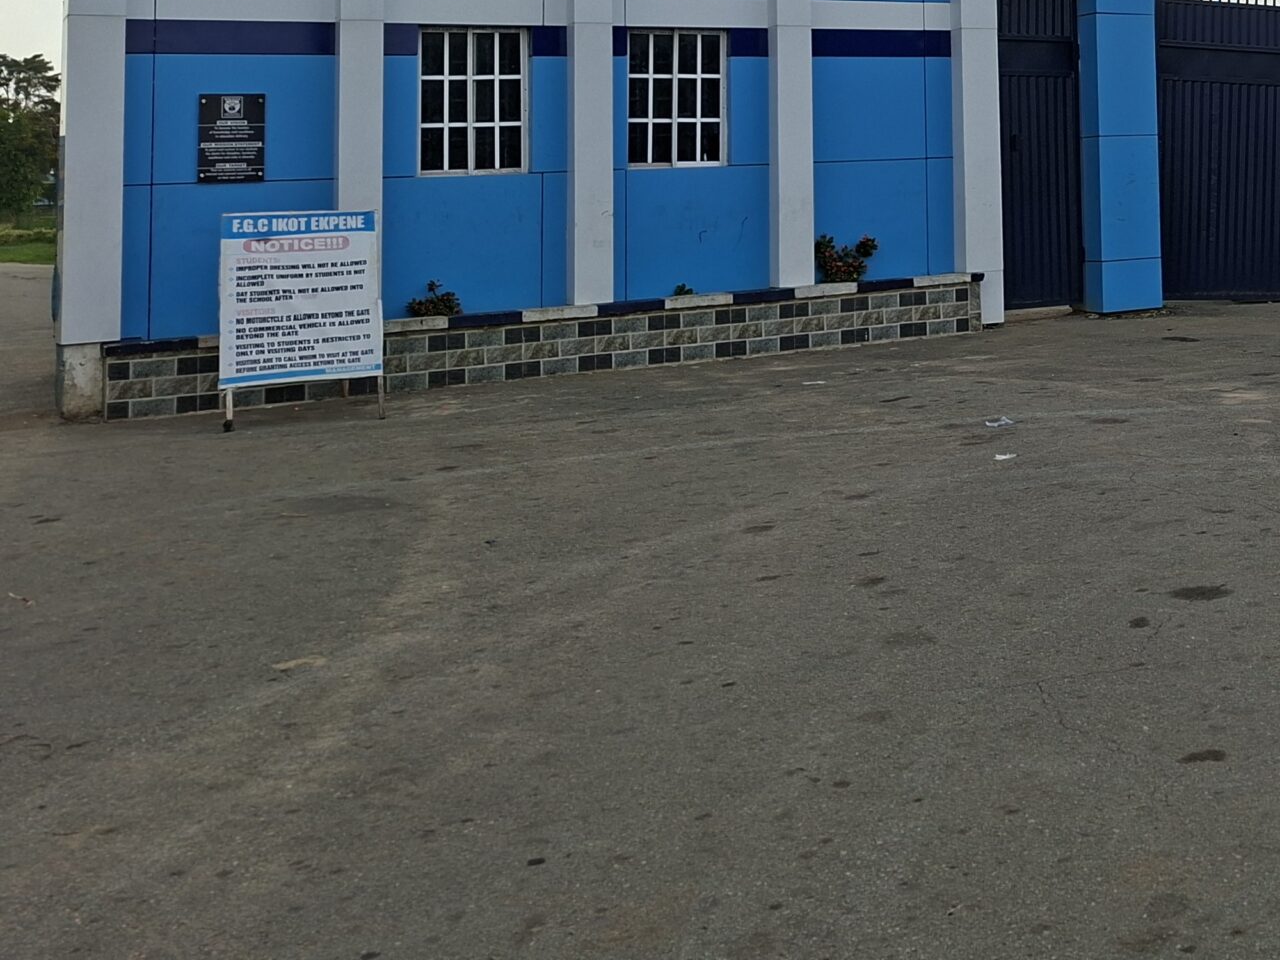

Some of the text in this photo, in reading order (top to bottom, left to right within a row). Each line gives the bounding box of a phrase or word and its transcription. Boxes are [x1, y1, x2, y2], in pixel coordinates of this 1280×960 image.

[232, 215, 366, 233] F.G.C IKOT EKPENE
[251, 237, 345, 252] NOTICE!!!
[250, 289, 280, 297] STUDENTS
[246, 315, 283, 324] MOTORCYCLE
[293, 313, 319, 321] ALLOWED
[321, 311, 343, 319] BEYOND
[248, 324, 296, 332] COMMERCIAL
[338, 318, 370, 327] ALLOWED
[277, 339, 311, 347] STUDENTS
[322, 335, 361, 343] RESTRICTED
